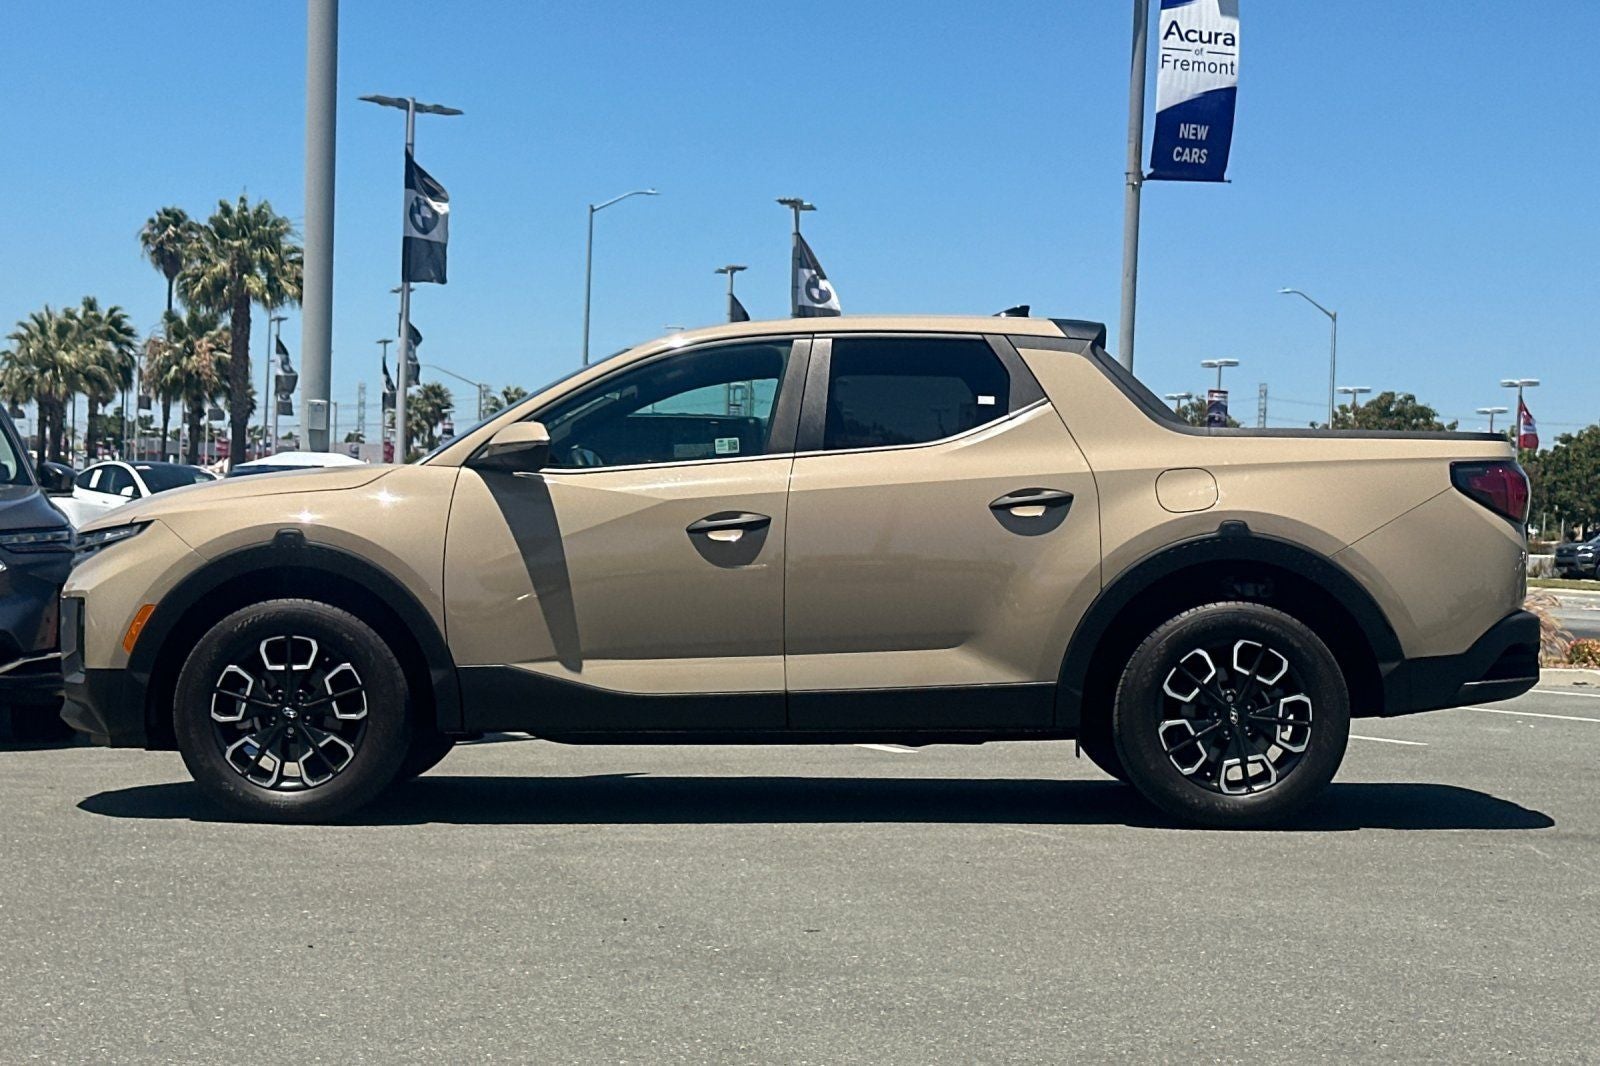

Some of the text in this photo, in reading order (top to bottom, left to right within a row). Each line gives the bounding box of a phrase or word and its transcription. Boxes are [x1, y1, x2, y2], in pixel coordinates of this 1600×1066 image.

[1163, 20, 1236, 47] Acura
[1194, 48, 1204, 56] of
[1161, 54, 1235, 75] Fremont
[1179, 123, 1209, 140] NEW
[1173, 147, 1208, 164] CARS
